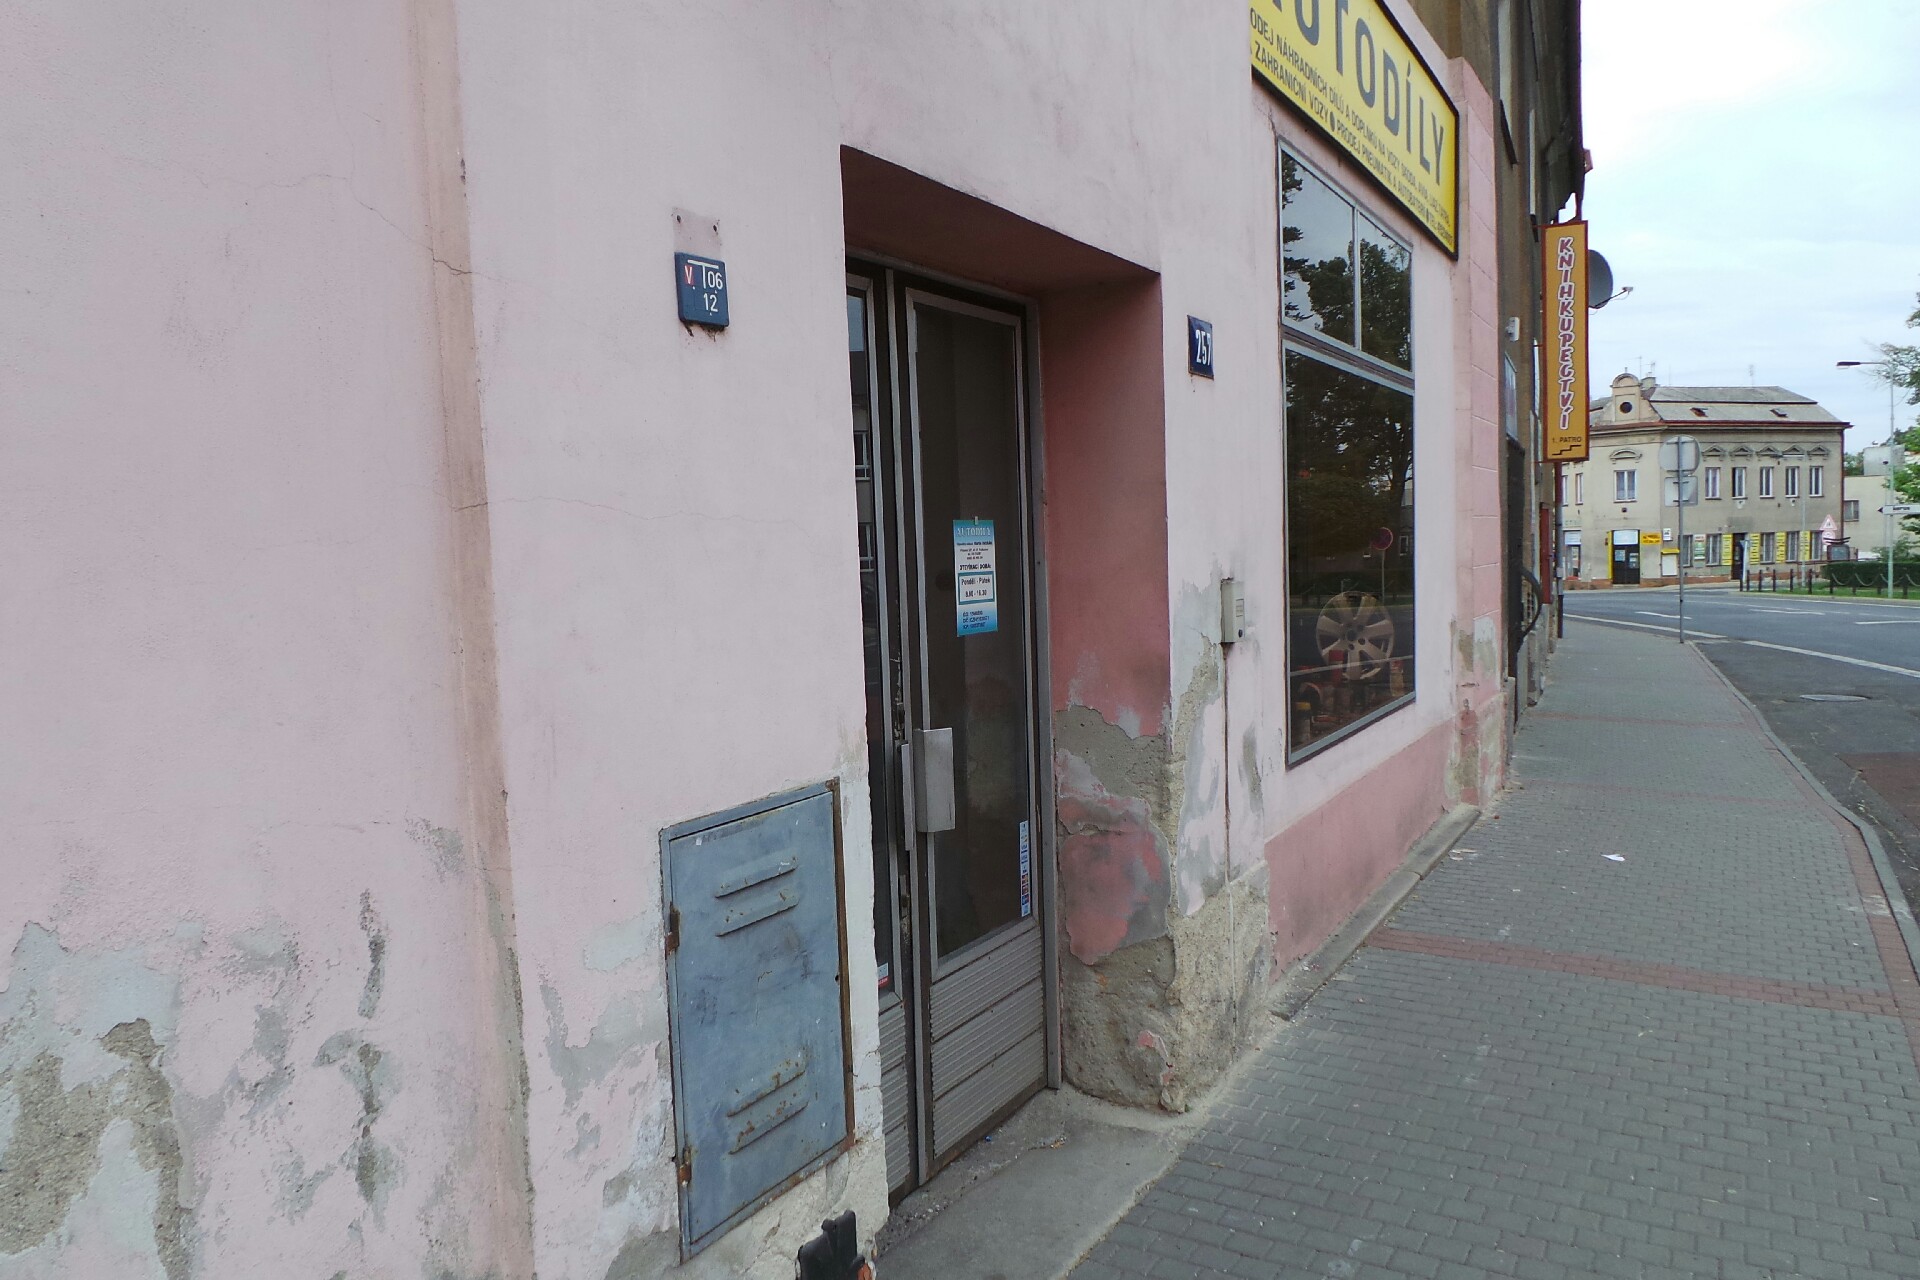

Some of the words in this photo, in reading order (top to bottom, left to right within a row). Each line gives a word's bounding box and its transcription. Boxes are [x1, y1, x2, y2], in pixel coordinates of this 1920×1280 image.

[1276, 33, 1327, 98] NÁHRADNÍCH
[1345, 104, 1350, 121] A
[1308, 90, 1328, 122] VOZY
[1195, 329, 1211, 366] 257
[1558, 237, 1575, 430] KNIHKUPECTVÍ
